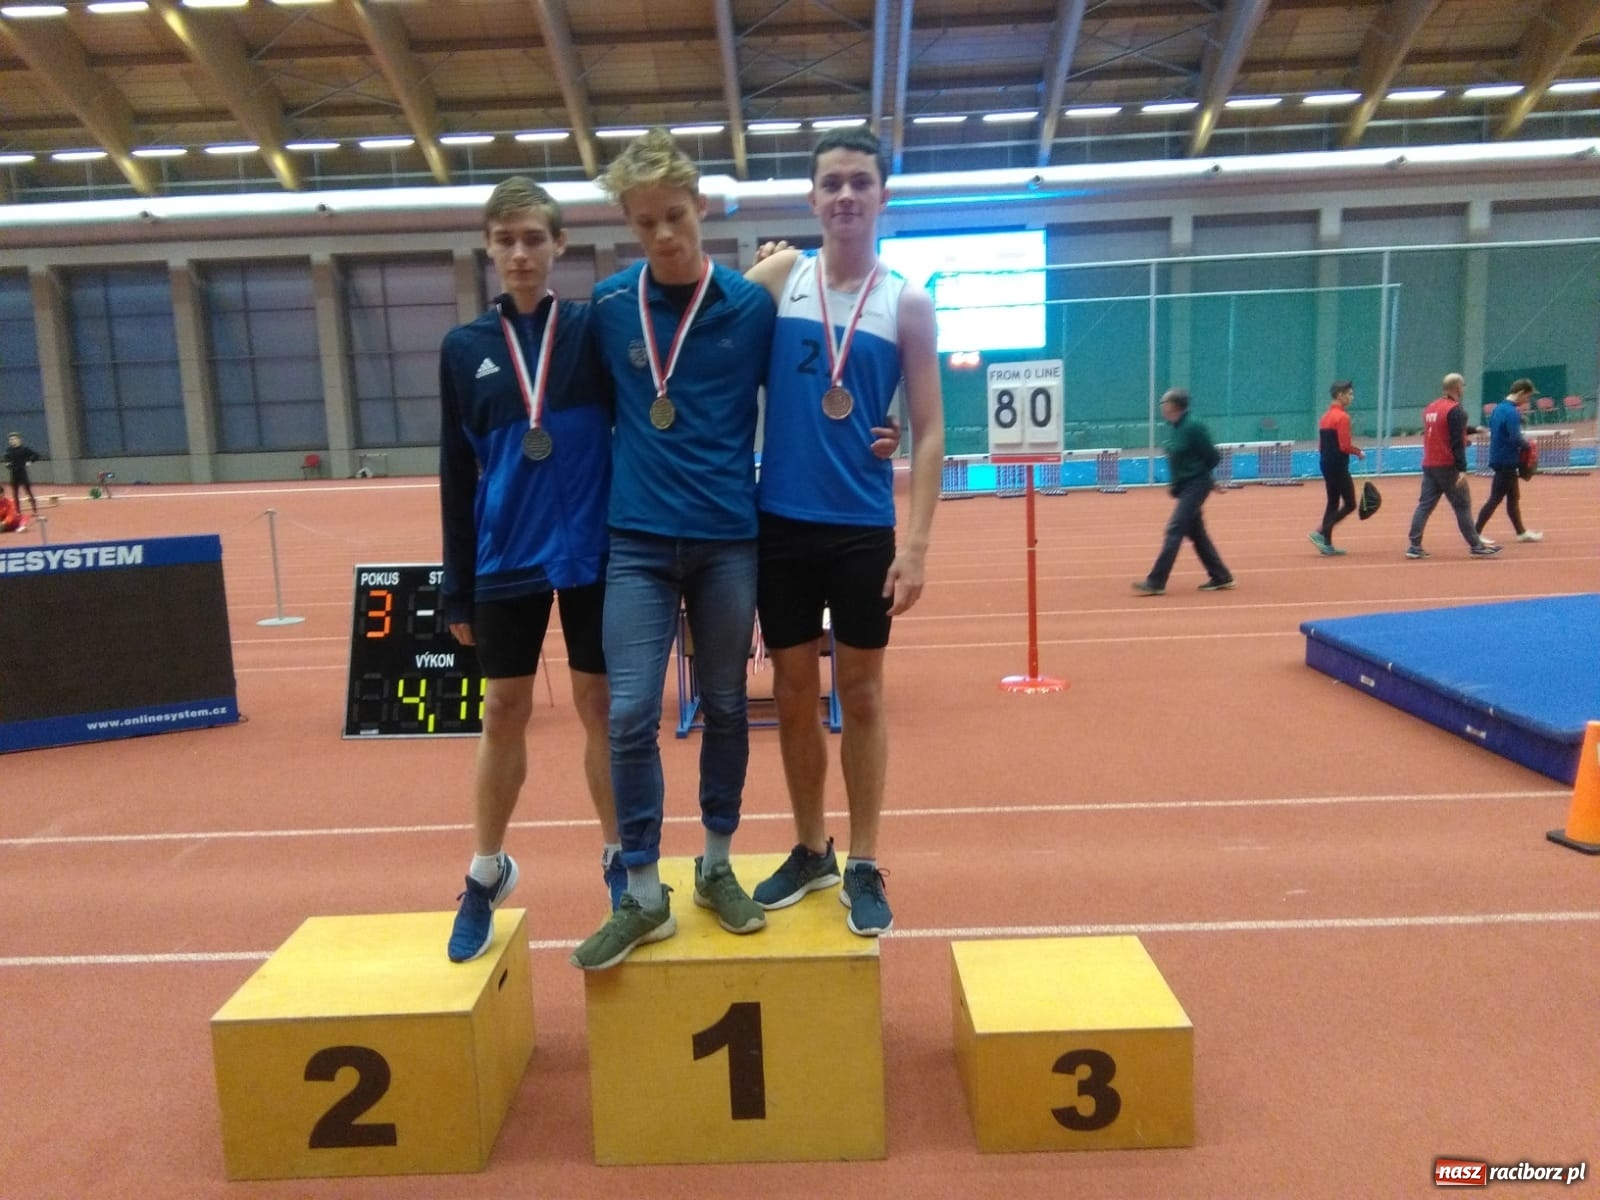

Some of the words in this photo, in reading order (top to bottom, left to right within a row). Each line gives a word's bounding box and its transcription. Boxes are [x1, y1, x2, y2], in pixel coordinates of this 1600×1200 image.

[797, 339, 831, 376] 2
[990, 369, 1020, 381] FROM
[1035, 366, 1061, 378] LINE
[361, 572, 400, 585] POKUS
[366, 590, 392, 638] 3
[415, 651, 455, 668] VÝKON
[86, 706, 227, 730] www.onlinesystem.cz
[692, 1002, 766, 1120] 1
[304, 1046, 397, 1149] 2
[1051, 1049, 1121, 1131] 3
